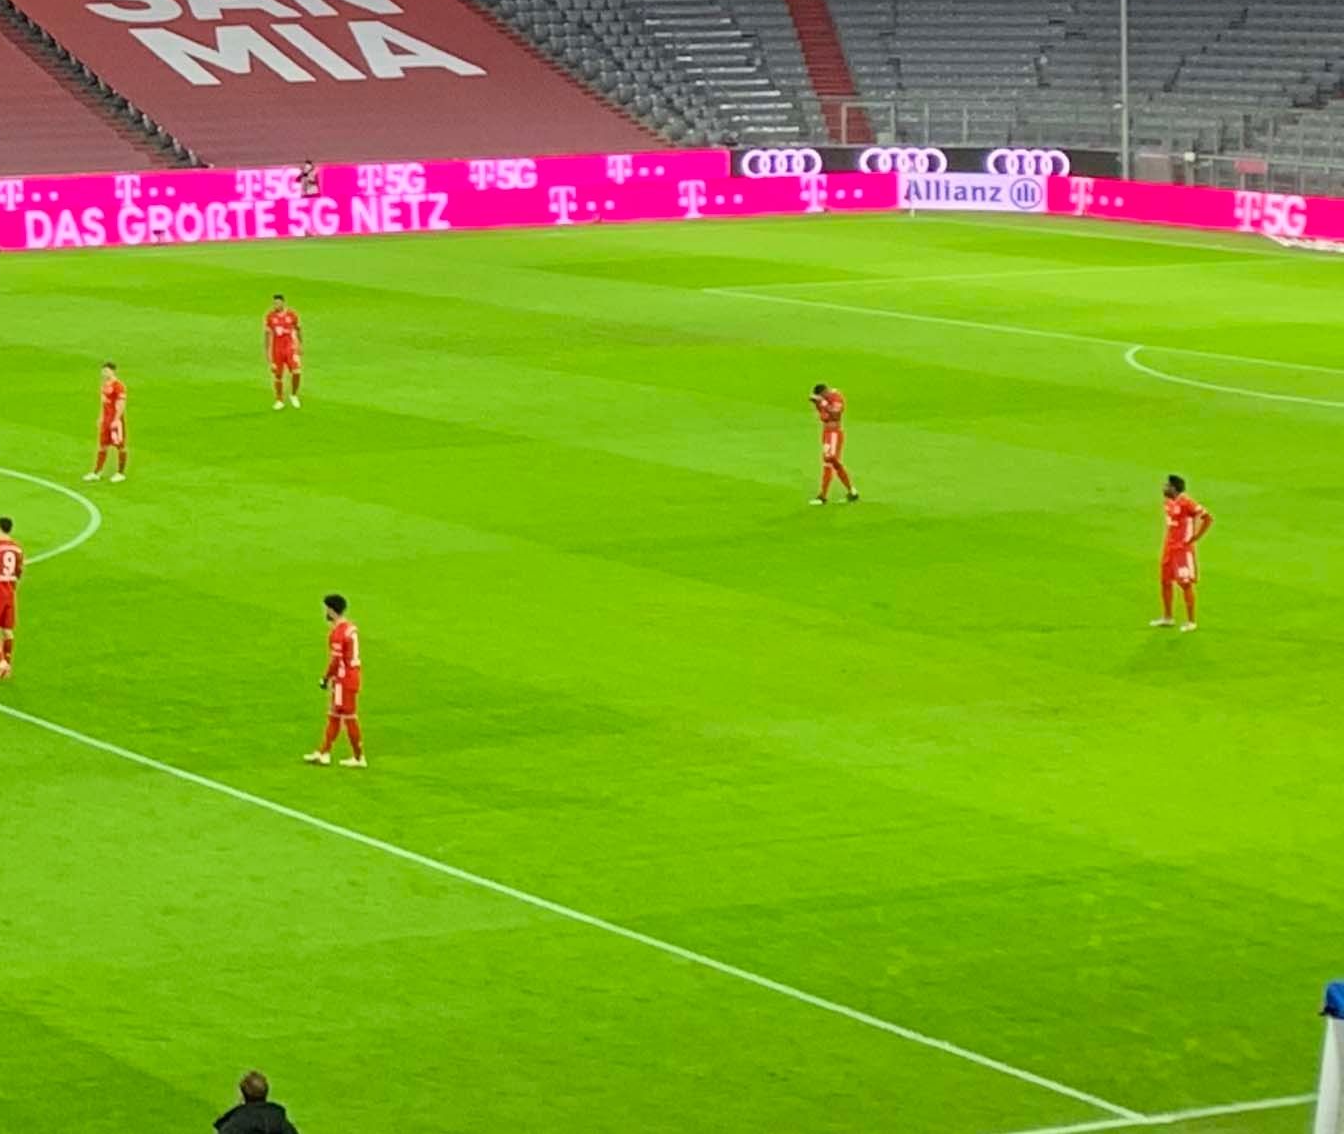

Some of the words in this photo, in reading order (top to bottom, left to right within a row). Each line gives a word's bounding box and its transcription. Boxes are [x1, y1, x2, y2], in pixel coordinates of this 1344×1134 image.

[128, 20, 488, 86] MIA
[906, 178, 1003, 204] Allianz
[25, 206, 106, 249] DAS
[288, 199, 340, 238] 5G
[352, 193, 451, 234] NETZ
[2, 551, 17, 575] 9
